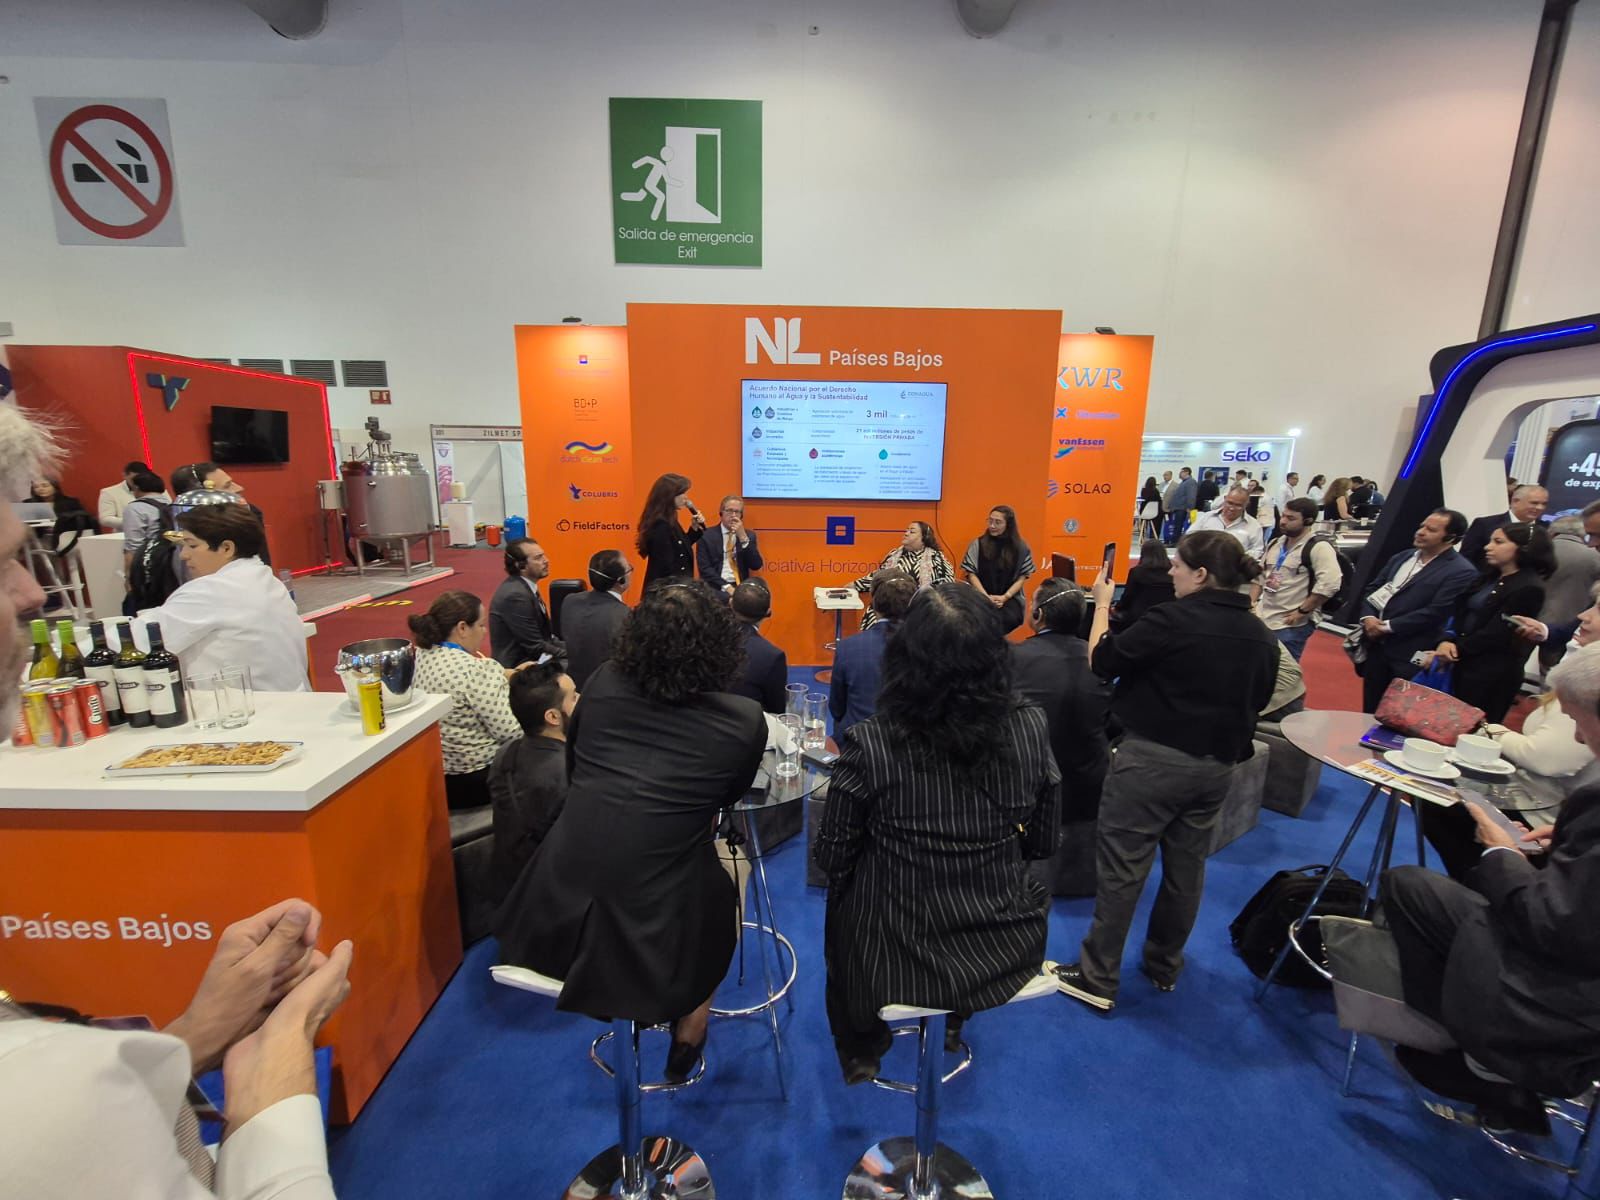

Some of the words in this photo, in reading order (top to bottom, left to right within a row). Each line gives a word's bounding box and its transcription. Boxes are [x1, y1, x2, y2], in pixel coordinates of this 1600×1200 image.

[618, 227, 656, 240] Salida
[659, 229, 677, 241] de
[679, 231, 754, 246] emergencia
[678, 246, 697, 259] Exit
[745, 317, 821, 364] NL
[829, 348, 888, 366] Países
[893, 349, 943, 371] Bajos
[749, 384, 778, 392] Acuerdo
[786, 393, 803, 401] Agua
[866, 409, 872, 418] 3
[873, 409, 888, 418] mil
[1058, 437, 1105, 446] vanEssen
[1564, 478, 1580, 487] de
[1064, 483, 1112, 494] SOLAQ
[573, 521, 630, 530] FieldFactors
[764, 558, 815, 574] iciativa
[0, 911, 112, 940] Países
[117, 913, 212, 948] Bajos
